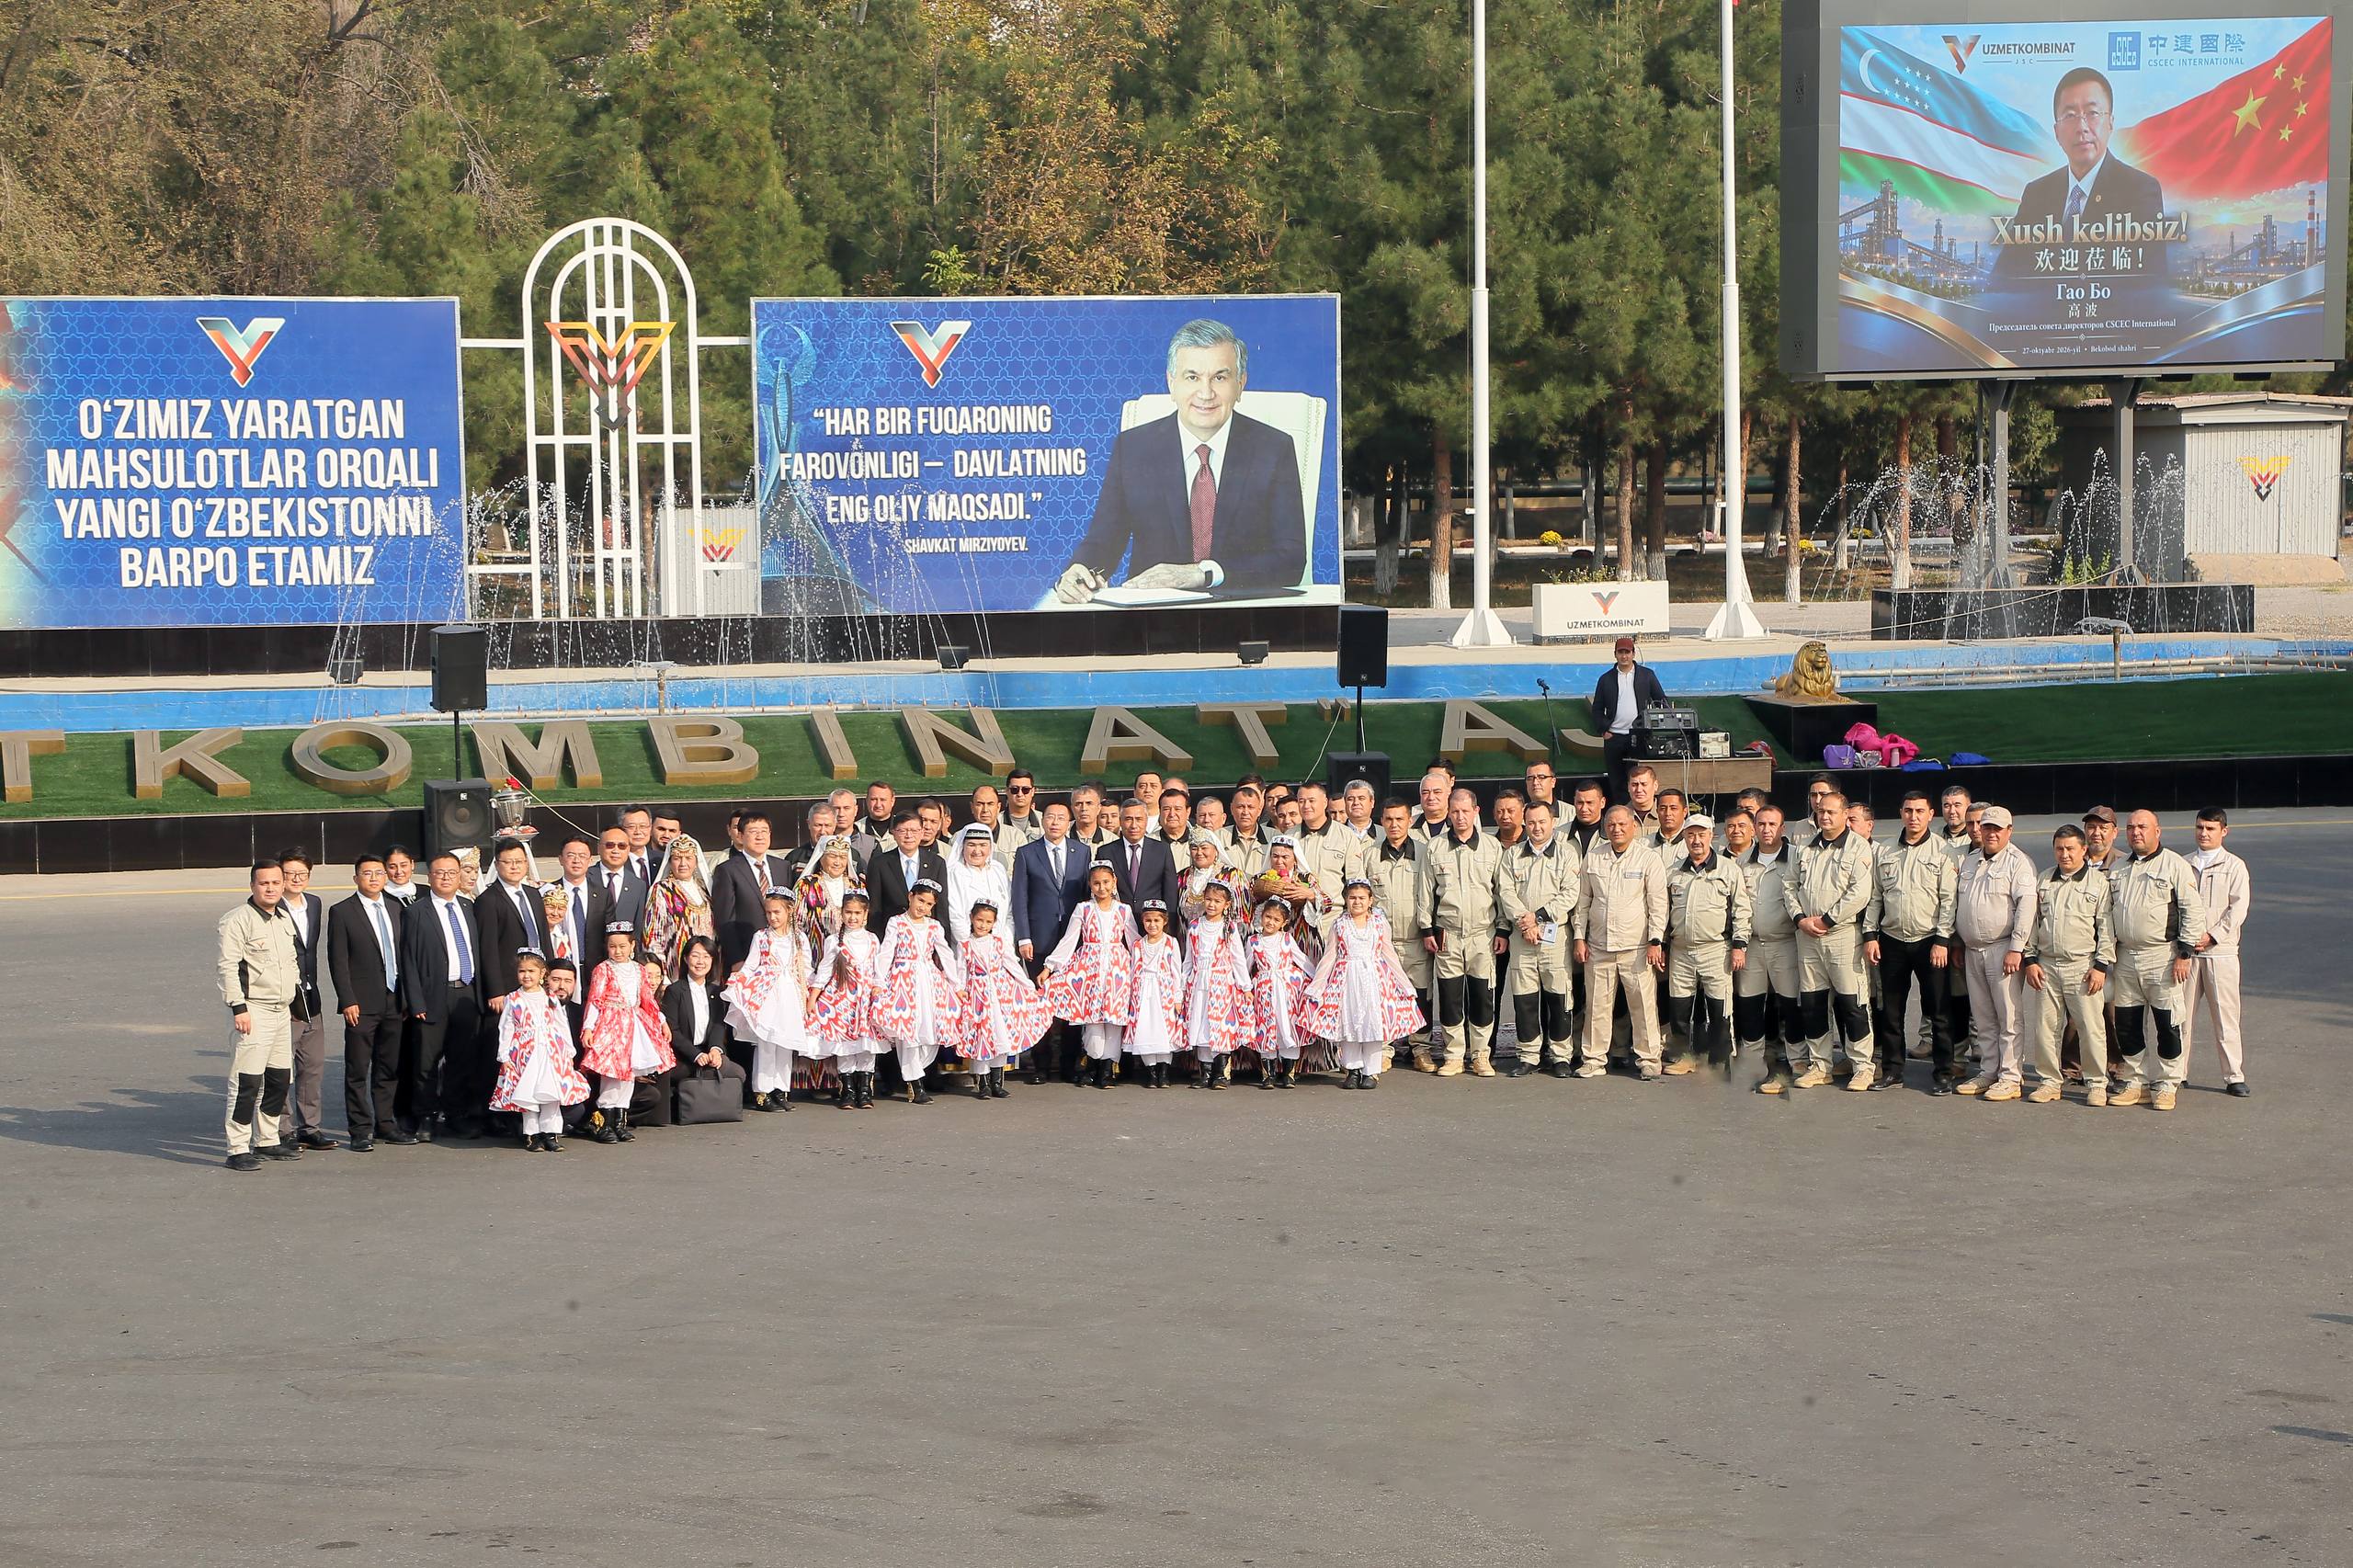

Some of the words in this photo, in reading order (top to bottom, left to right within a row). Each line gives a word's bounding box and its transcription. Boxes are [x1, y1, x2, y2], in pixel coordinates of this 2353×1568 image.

[1983, 42, 2075, 55] UZMETKOMBINAT
[2148, 33, 2245, 56] 中建國際
[2148, 58, 2175, 67] CSCEC
[2178, 57, 2245, 67] INTERNATIONAL
[1990, 213, 2064, 245] Xush
[2072, 211, 2188, 243] kelibsiz!
[2056, 283, 2086, 301] Гао
[2089, 282, 2111, 300] Бо
[2068, 302, 2097, 318] 高波
[2105, 320, 2131, 329] CSCEC
[2131, 319, 2177, 329] International
[79, 399, 212, 439] O‘ZIMIZ
[216, 399, 404, 439] YARATGAN
[813, 407, 870, 436] “HAR
[875, 406, 913, 435] BIR
[917, 405, 1052, 436] FUQARONING
[47, 448, 308, 490] MAHSULOTLAR
[316, 448, 438, 490] ORQALI
[779, 451, 919, 481] FAROVONLIGI
[955, 448, 1086, 477] DAVLATNING
[54, 496, 161, 540] YANGI
[171, 496, 433, 539] O‘ZBEKISTONNI
[826, 496, 869, 523] ENG
[875, 494, 921, 523] OLIY
[928, 492, 1042, 522] MAQSADI.”
[905, 538, 957, 554] SHAVKAT
[959, 537, 1029, 553] MIRZIYOYEV.
[120, 547, 238, 588] BARPO
[247, 546, 375, 587] ETAMIZ
[1566, 619, 1645, 630] UZMETKOMBINAT
